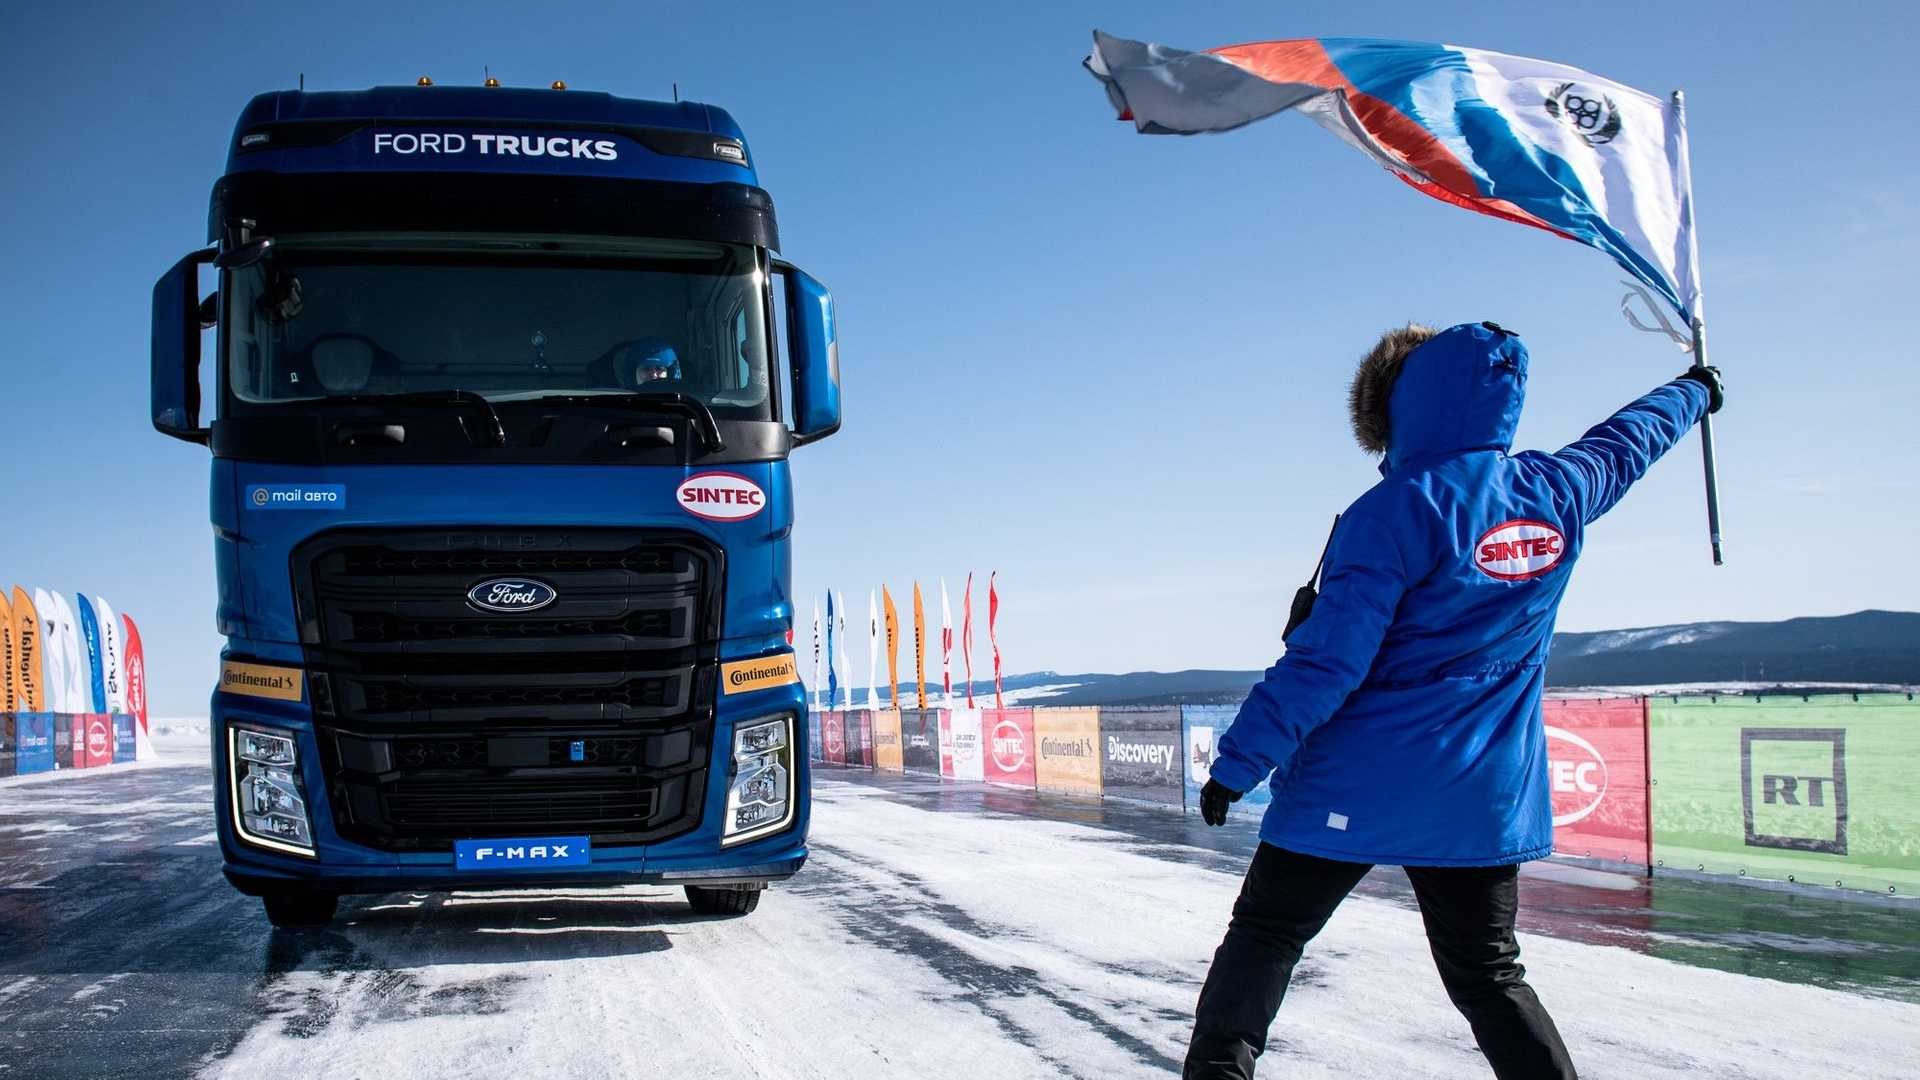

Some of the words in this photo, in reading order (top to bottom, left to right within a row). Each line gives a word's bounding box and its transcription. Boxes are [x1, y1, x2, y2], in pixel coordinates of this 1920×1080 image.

[374, 133, 466, 154] FORD
[472, 134, 618, 161] TRUCKS
[272, 488, 301, 502] mail
[682, 487, 761, 506] SINTEC
[1480, 535, 1560, 564] SINTEC
[487, 583, 536, 604] Ford
[223, 669, 283, 689] Continental
[730, 663, 789, 686] Continental
[991, 737, 1024, 755] SINTEC
[1041, 736, 1085, 760] Continental
[1108, 735, 1175, 771] Discovery
[1763, 774, 1834, 808] RT
[476, 845, 569, 861] F-MAX
